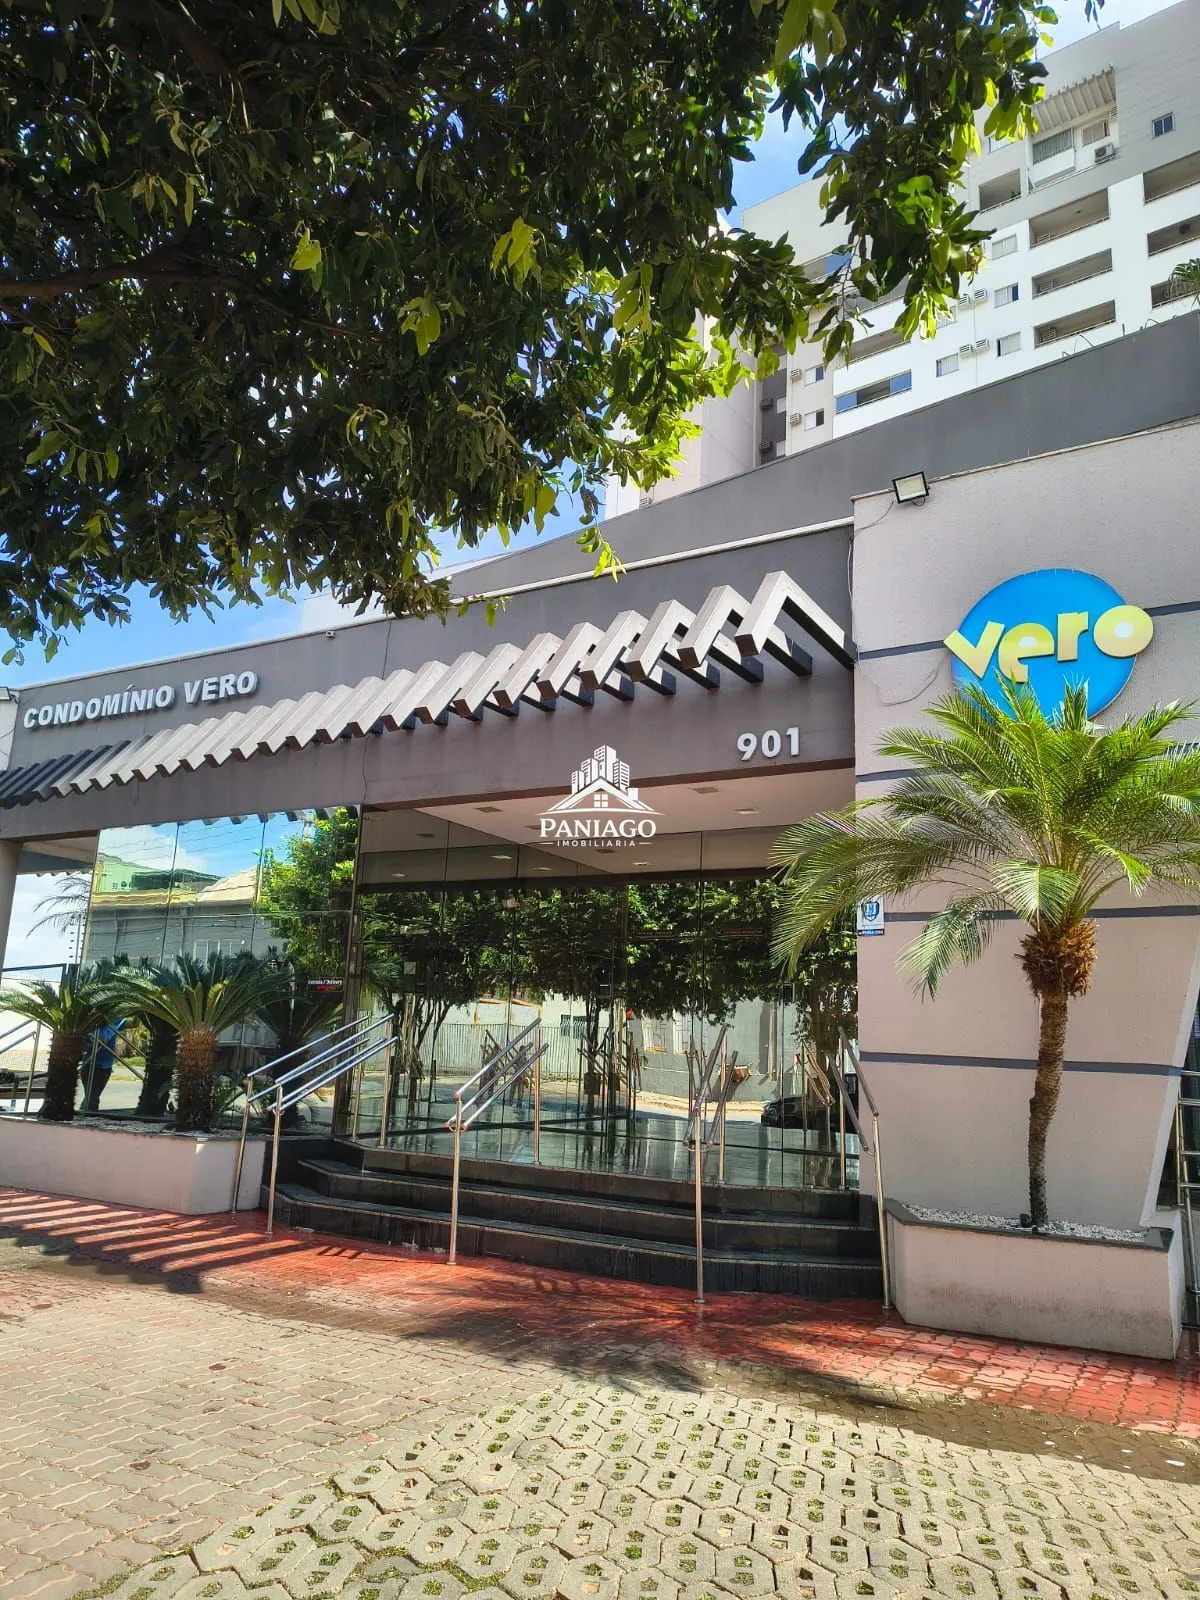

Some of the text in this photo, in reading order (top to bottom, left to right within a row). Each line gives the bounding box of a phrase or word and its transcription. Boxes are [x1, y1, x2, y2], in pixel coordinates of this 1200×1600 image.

[943, 605, 1154, 683] vero
[23, 671, 258, 729] CONDOMÍNIO VERO
[736, 726, 800, 761] 901
